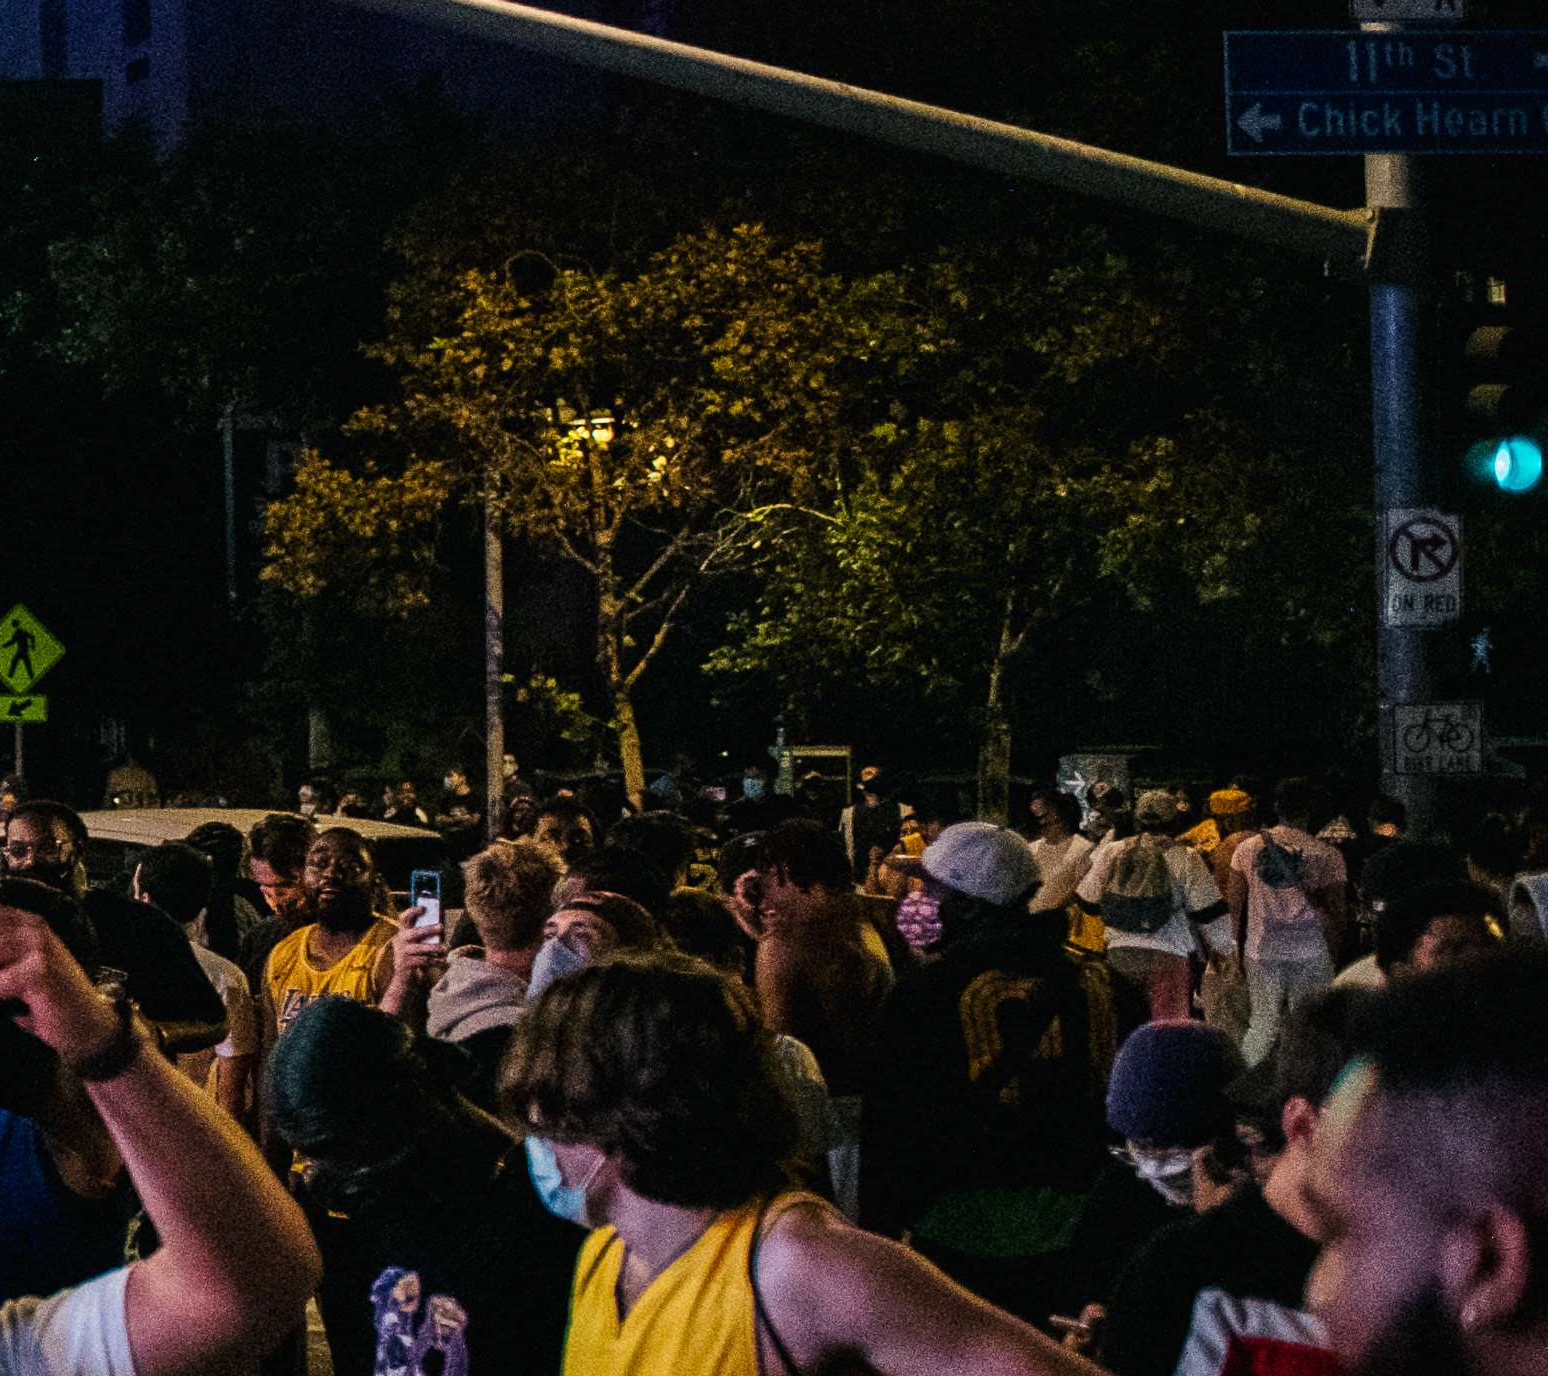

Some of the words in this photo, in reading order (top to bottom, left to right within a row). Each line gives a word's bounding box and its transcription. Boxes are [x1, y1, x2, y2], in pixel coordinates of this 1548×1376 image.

[1346, 40, 1415, 83] 11th
[1435, 43, 1475, 80] St
[1298, 101, 1403, 137] Chick
[1416, 100, 1528, 137] Hearn
[1423, 594, 1456, 613] RED
